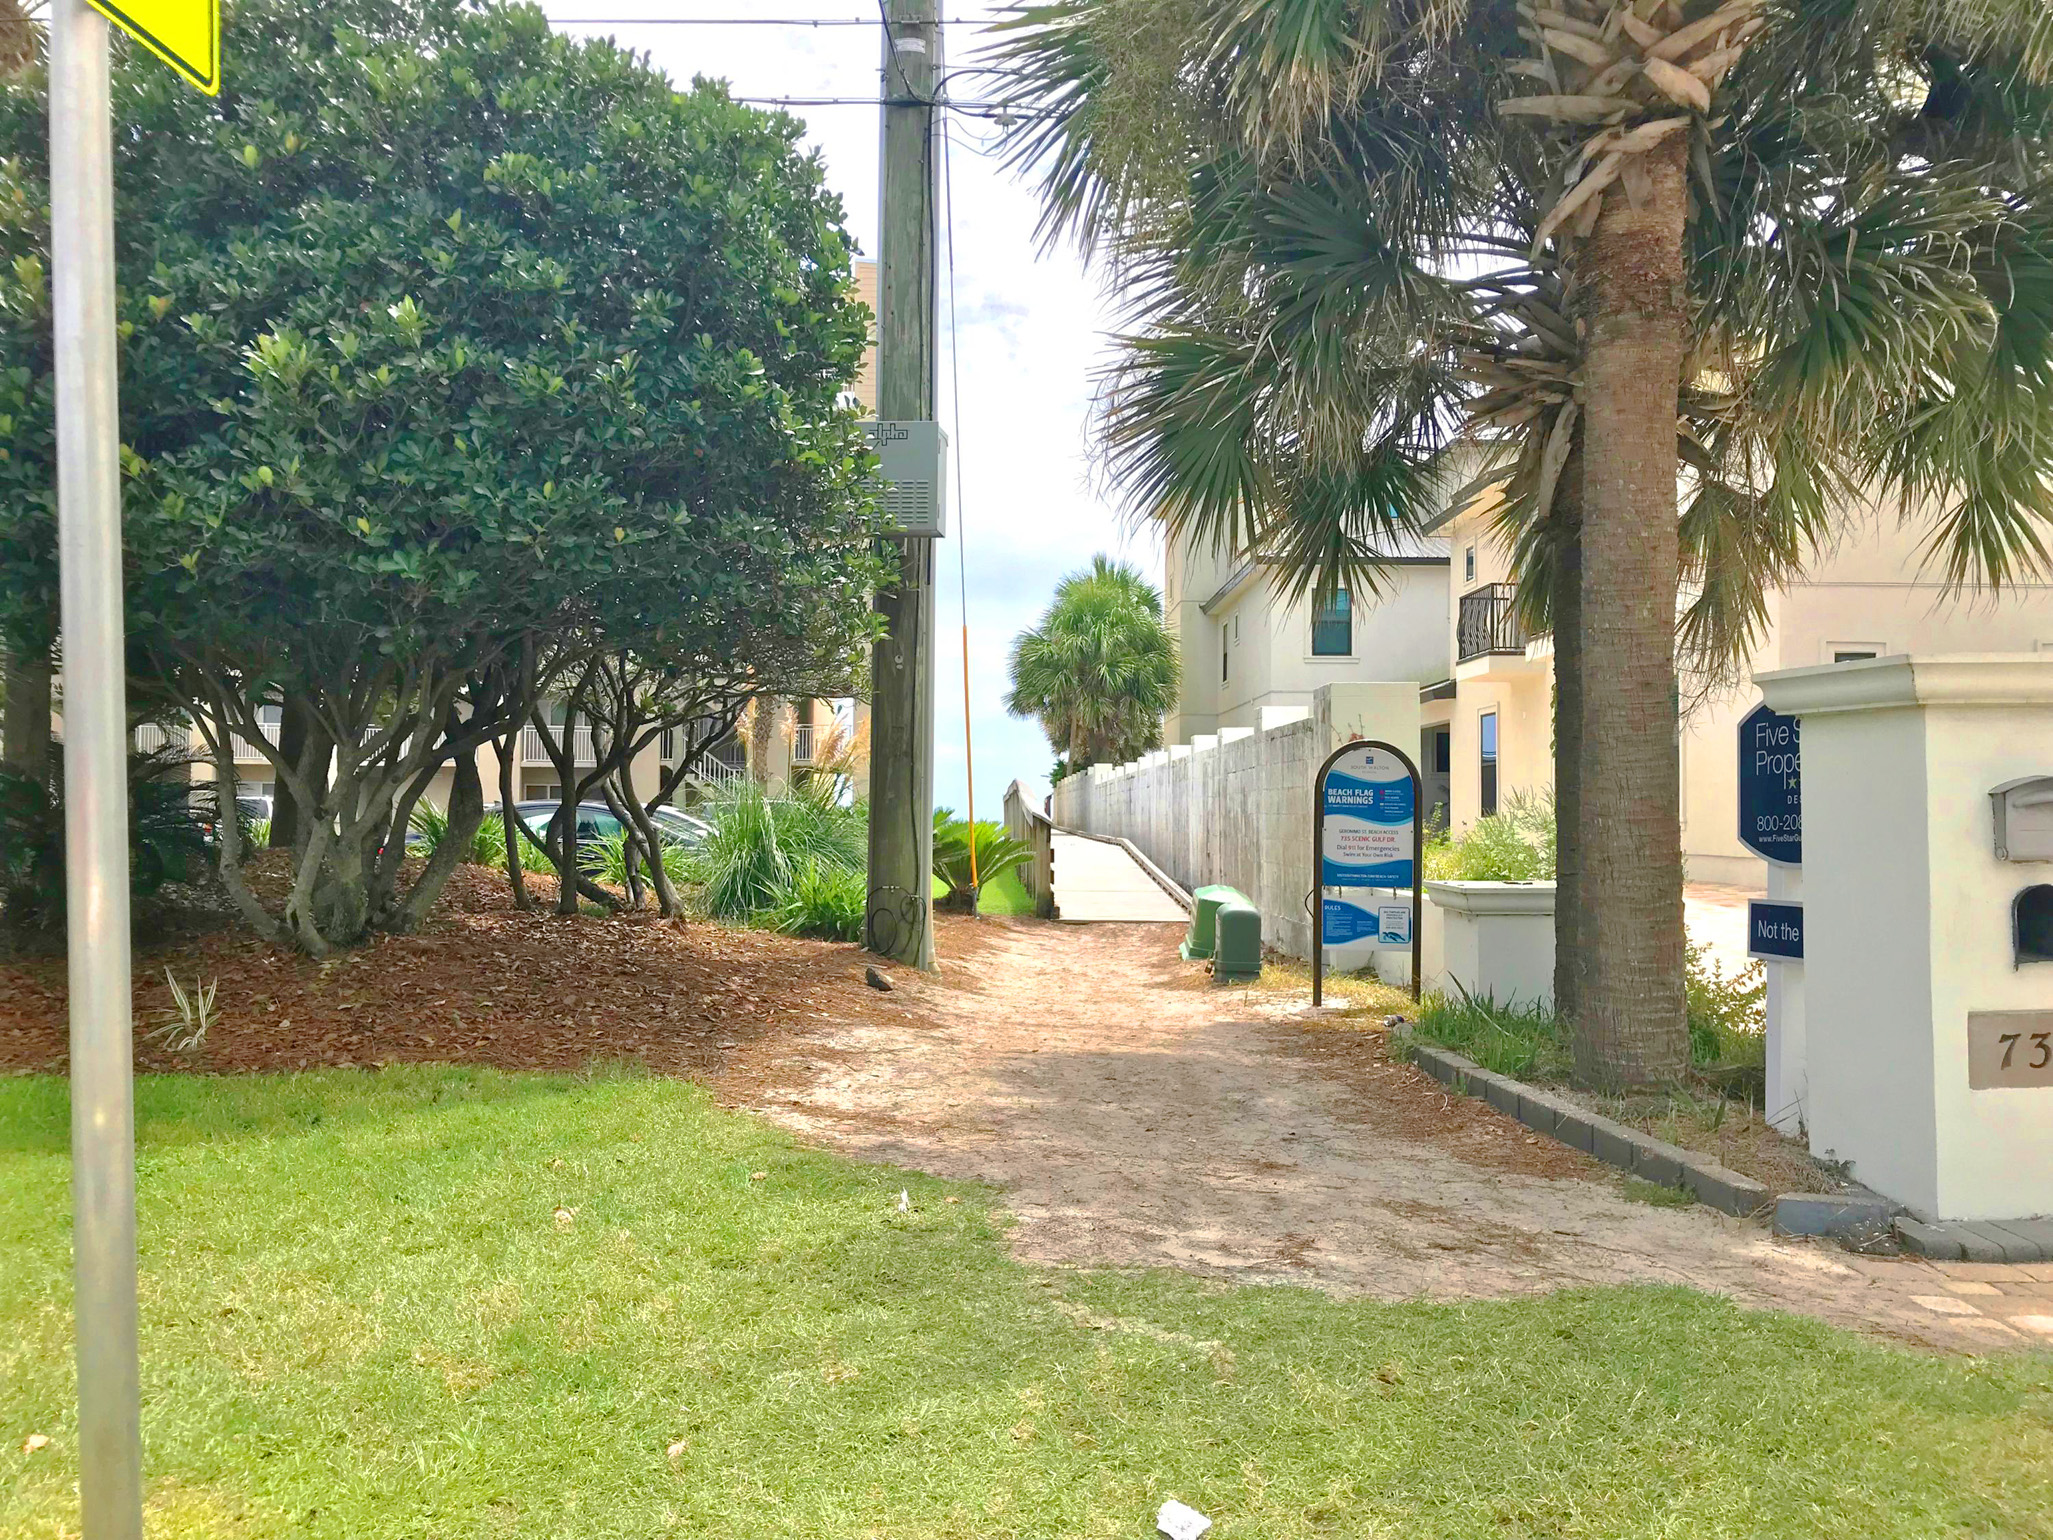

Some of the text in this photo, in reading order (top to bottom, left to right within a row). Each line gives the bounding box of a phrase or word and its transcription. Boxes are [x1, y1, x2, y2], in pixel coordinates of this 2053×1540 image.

[1756, 722, 1789, 748] Five
[1756, 750, 1801, 790] Prope
[1328, 796, 1373, 804] WARNINGS
[1787, 794, 1802, 804] DE
[1758, 919, 1800, 942] Not the
[1998, 1031, 2052, 1071] 73
